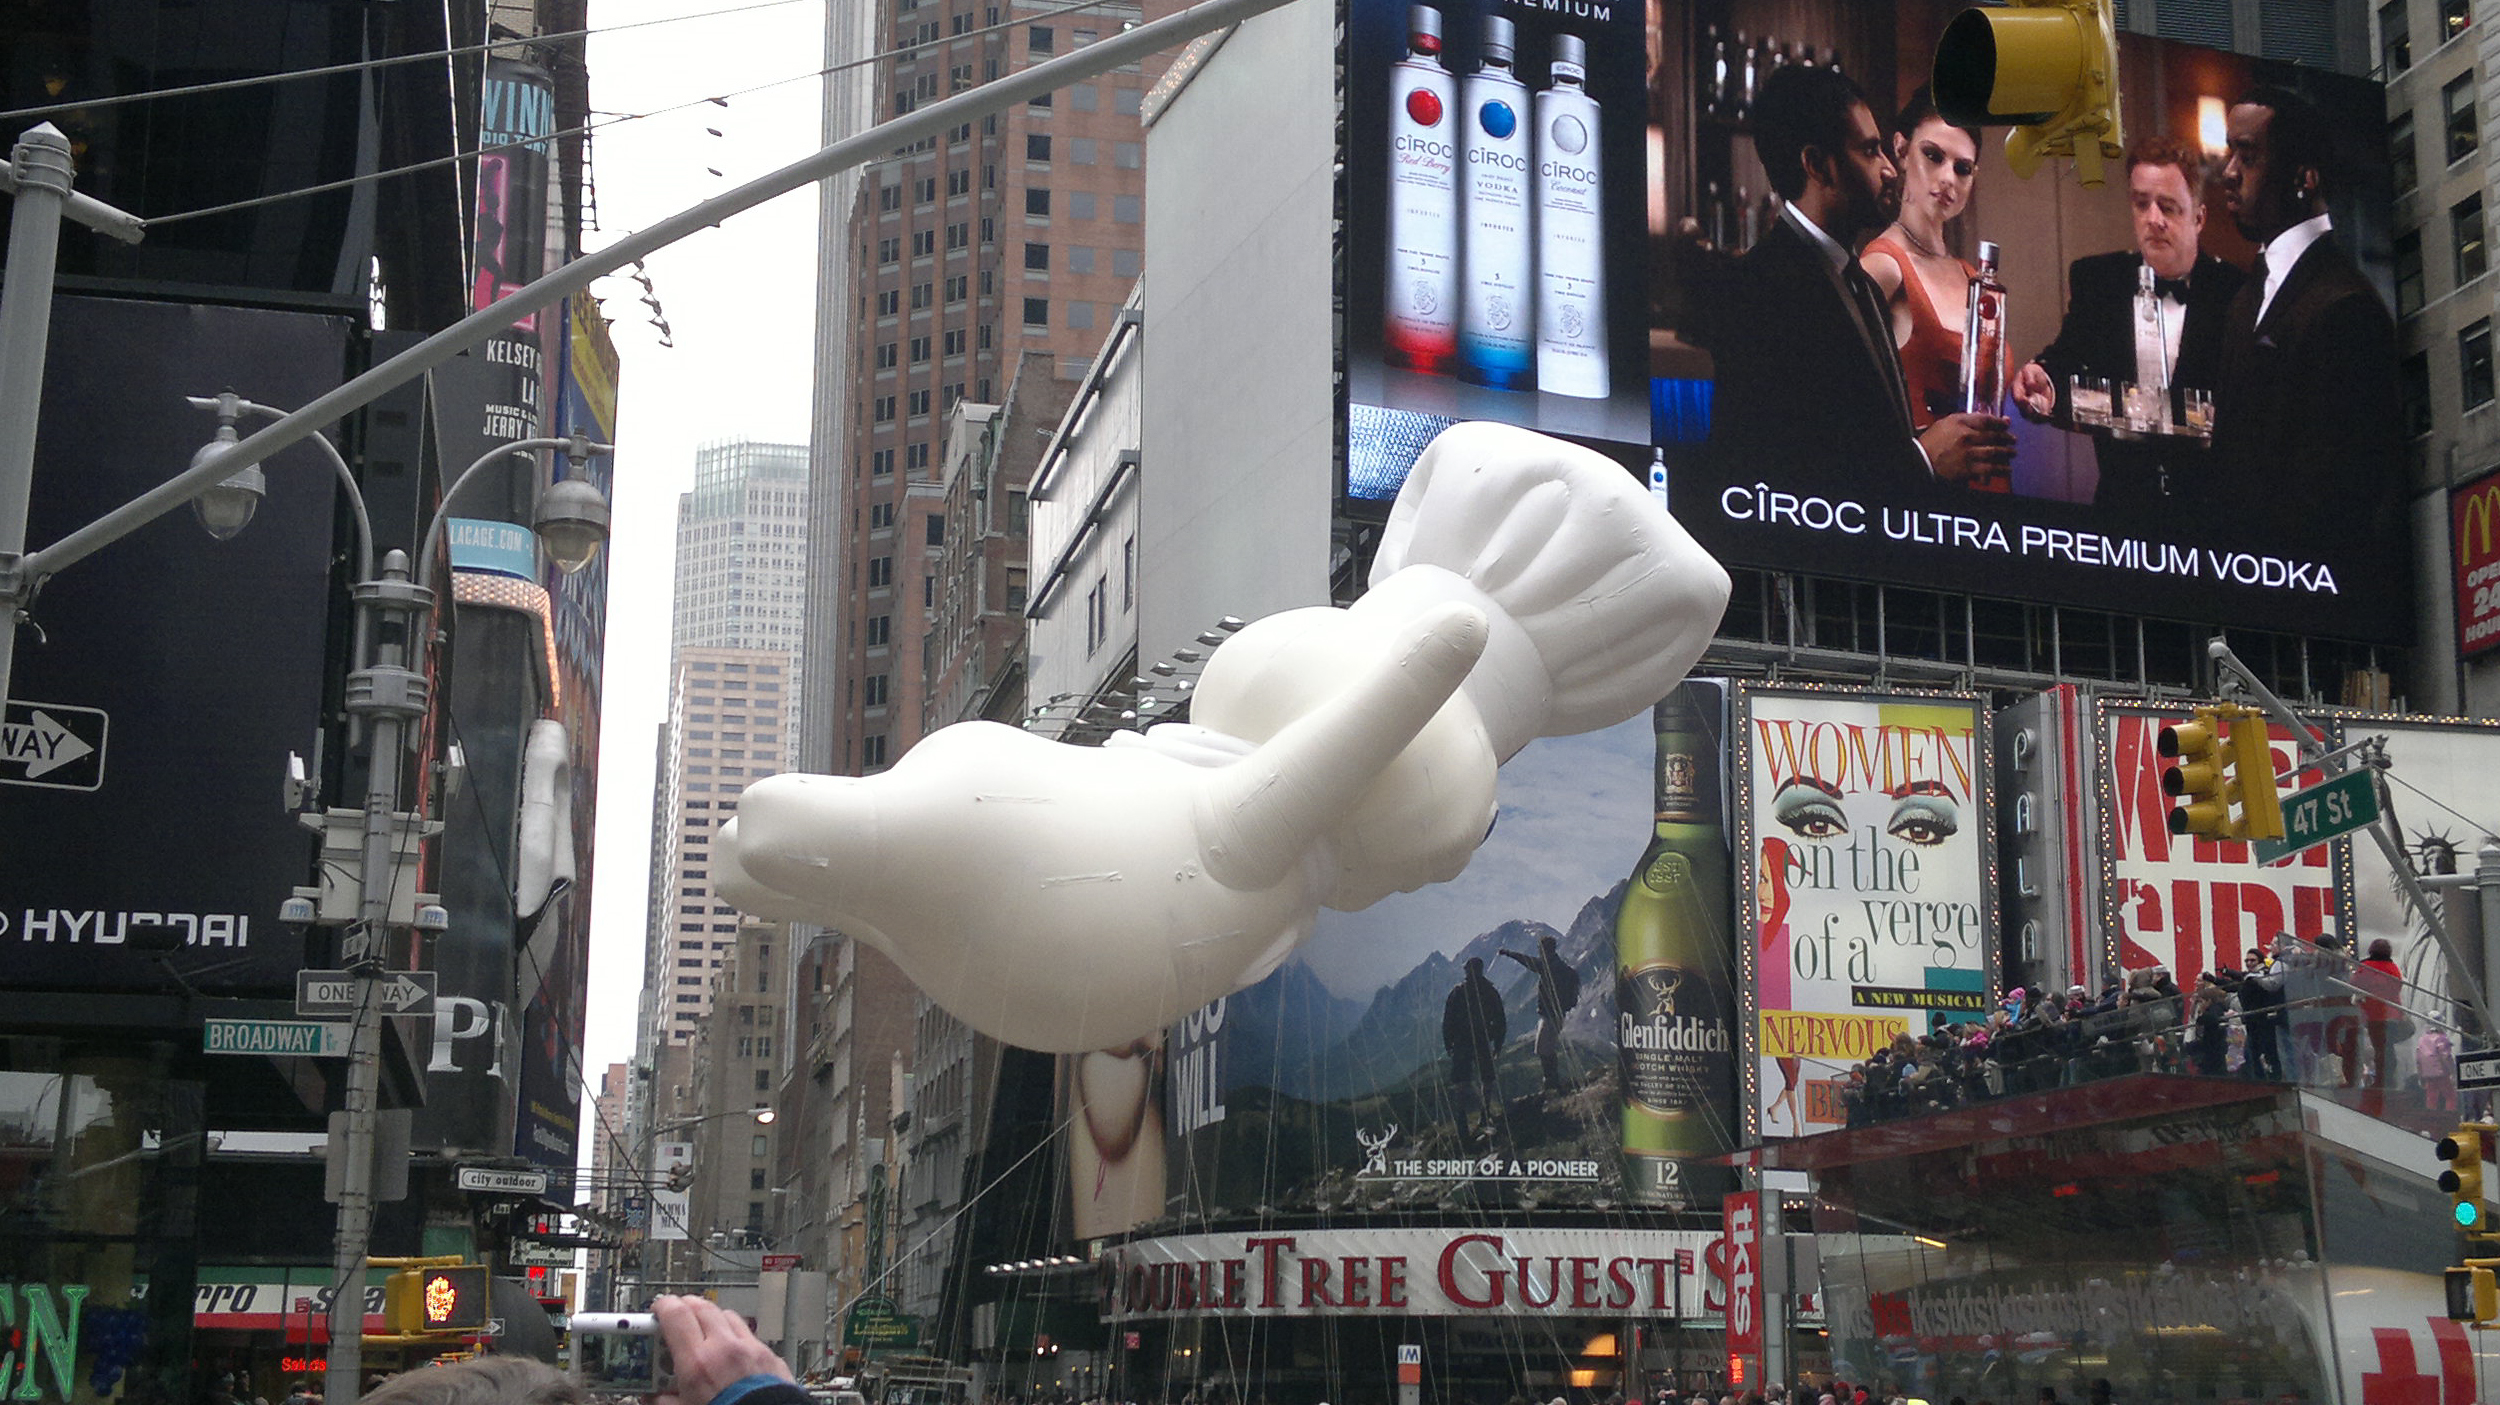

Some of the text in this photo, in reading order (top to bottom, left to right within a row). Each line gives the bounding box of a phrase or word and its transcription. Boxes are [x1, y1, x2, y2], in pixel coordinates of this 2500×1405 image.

[1541, 161, 1597, 185] CÎROC
[486, 339, 536, 369] KELSEY
[483, 414, 523, 440] JERRY
[485, 404, 520, 416] MUSIC
[1721, 482, 2339, 595] CÎROC ULTRA PREMIUM VODKA
[1753, 718, 1975, 803] WOMEN
[2293, 789, 2353, 836] 47 St
[1784, 826, 1920, 894] on the
[1794, 913, 1877, 983] of a
[1860, 899, 1979, 968] verge
[318, 984, 354, 1001] ONE
[1854, 992, 1985, 1008] A NEW MUSICAL
[210, 1024, 316, 1051] BROADWAY
[1621, 1012, 1729, 1052] Glenfiddich
[1764, 1016, 1903, 1057] NERVOUS
[1176, 1040, 1226, 1136] WILL
[2465, 1063, 2485, 1078] ONE
[471, 1173, 536, 1188] city outdoor
[1394, 1160, 1599, 1177] THE SPIRIT OF A PIONEER
[1656, 1161, 1679, 1185] 12
[1437, 1234, 1675, 1310] GUEST
[1733, 1202, 1754, 1336] tkts
